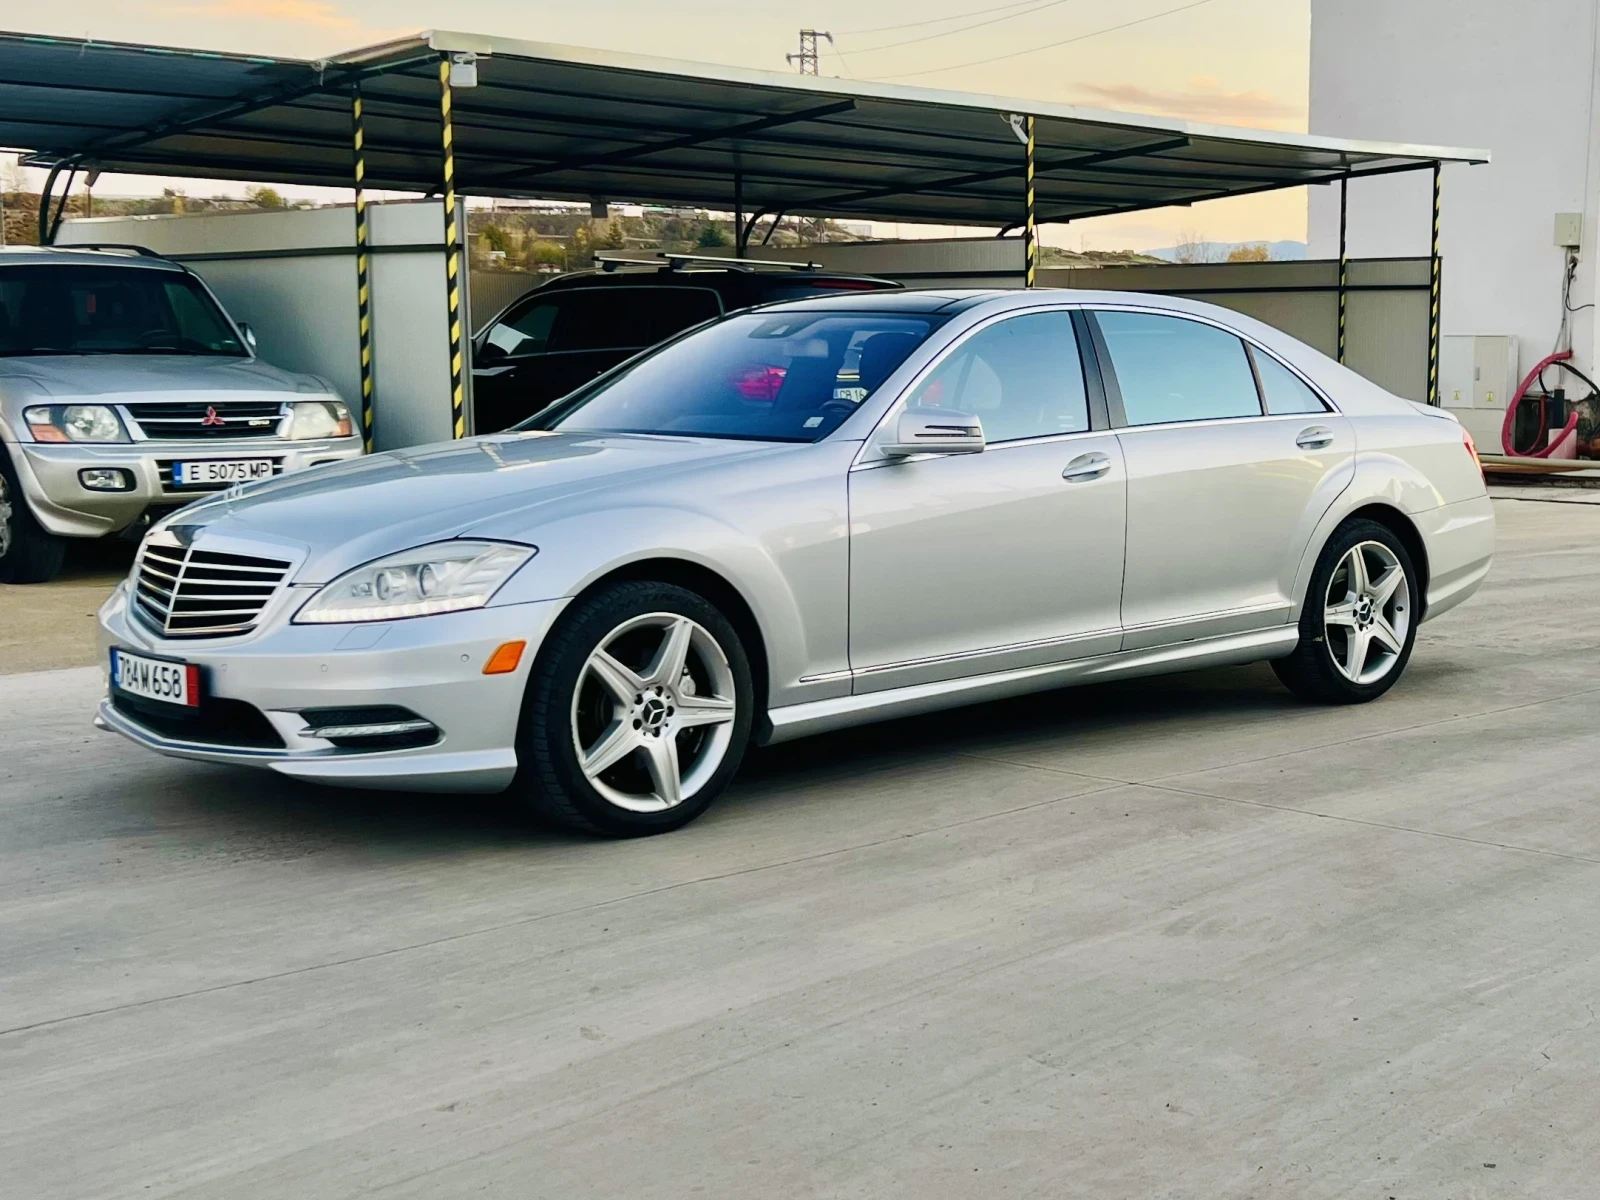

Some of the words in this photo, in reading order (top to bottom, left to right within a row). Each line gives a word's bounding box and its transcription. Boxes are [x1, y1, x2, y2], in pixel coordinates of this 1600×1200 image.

[190, 465, 200, 480] E
[208, 463, 247, 479] 5075
[249, 462, 270, 478] MP
